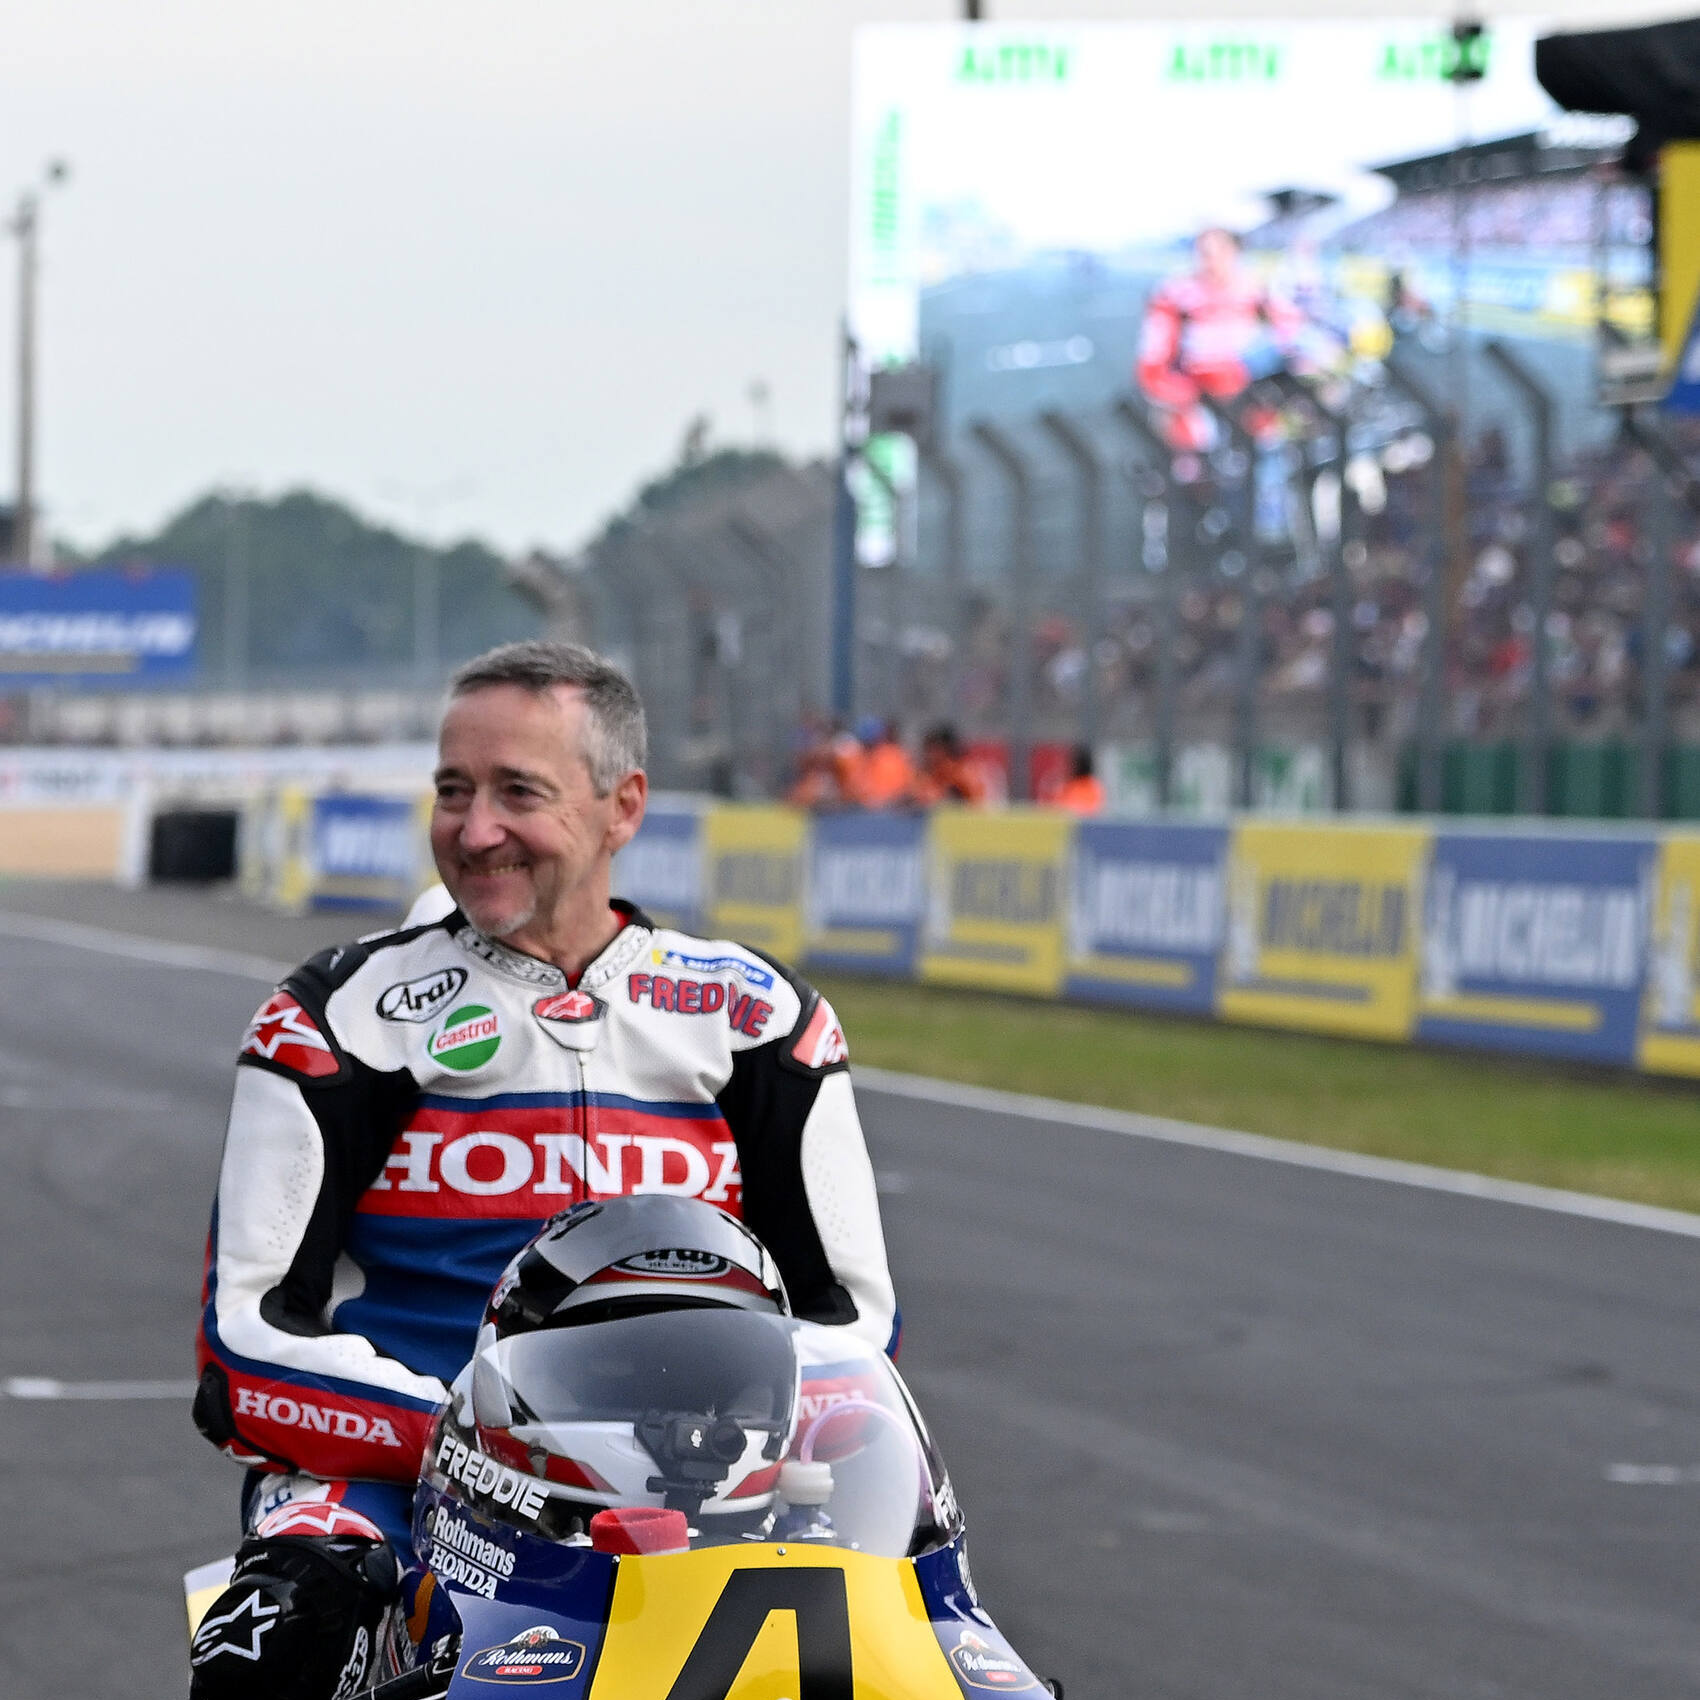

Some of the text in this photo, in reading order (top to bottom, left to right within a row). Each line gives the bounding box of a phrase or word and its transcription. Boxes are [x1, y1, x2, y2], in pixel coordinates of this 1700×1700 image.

[389, 969, 457, 1013] Arai
[436, 1015, 498, 1050] Castrol
[234, 1387, 402, 1447] HONDA
[435, 1434, 551, 1521] FREDDIE
[432, 1506, 517, 1577] Rothmans
[428, 1543, 499, 1600] HONDA
[477, 1648, 575, 1667] Rothmans
